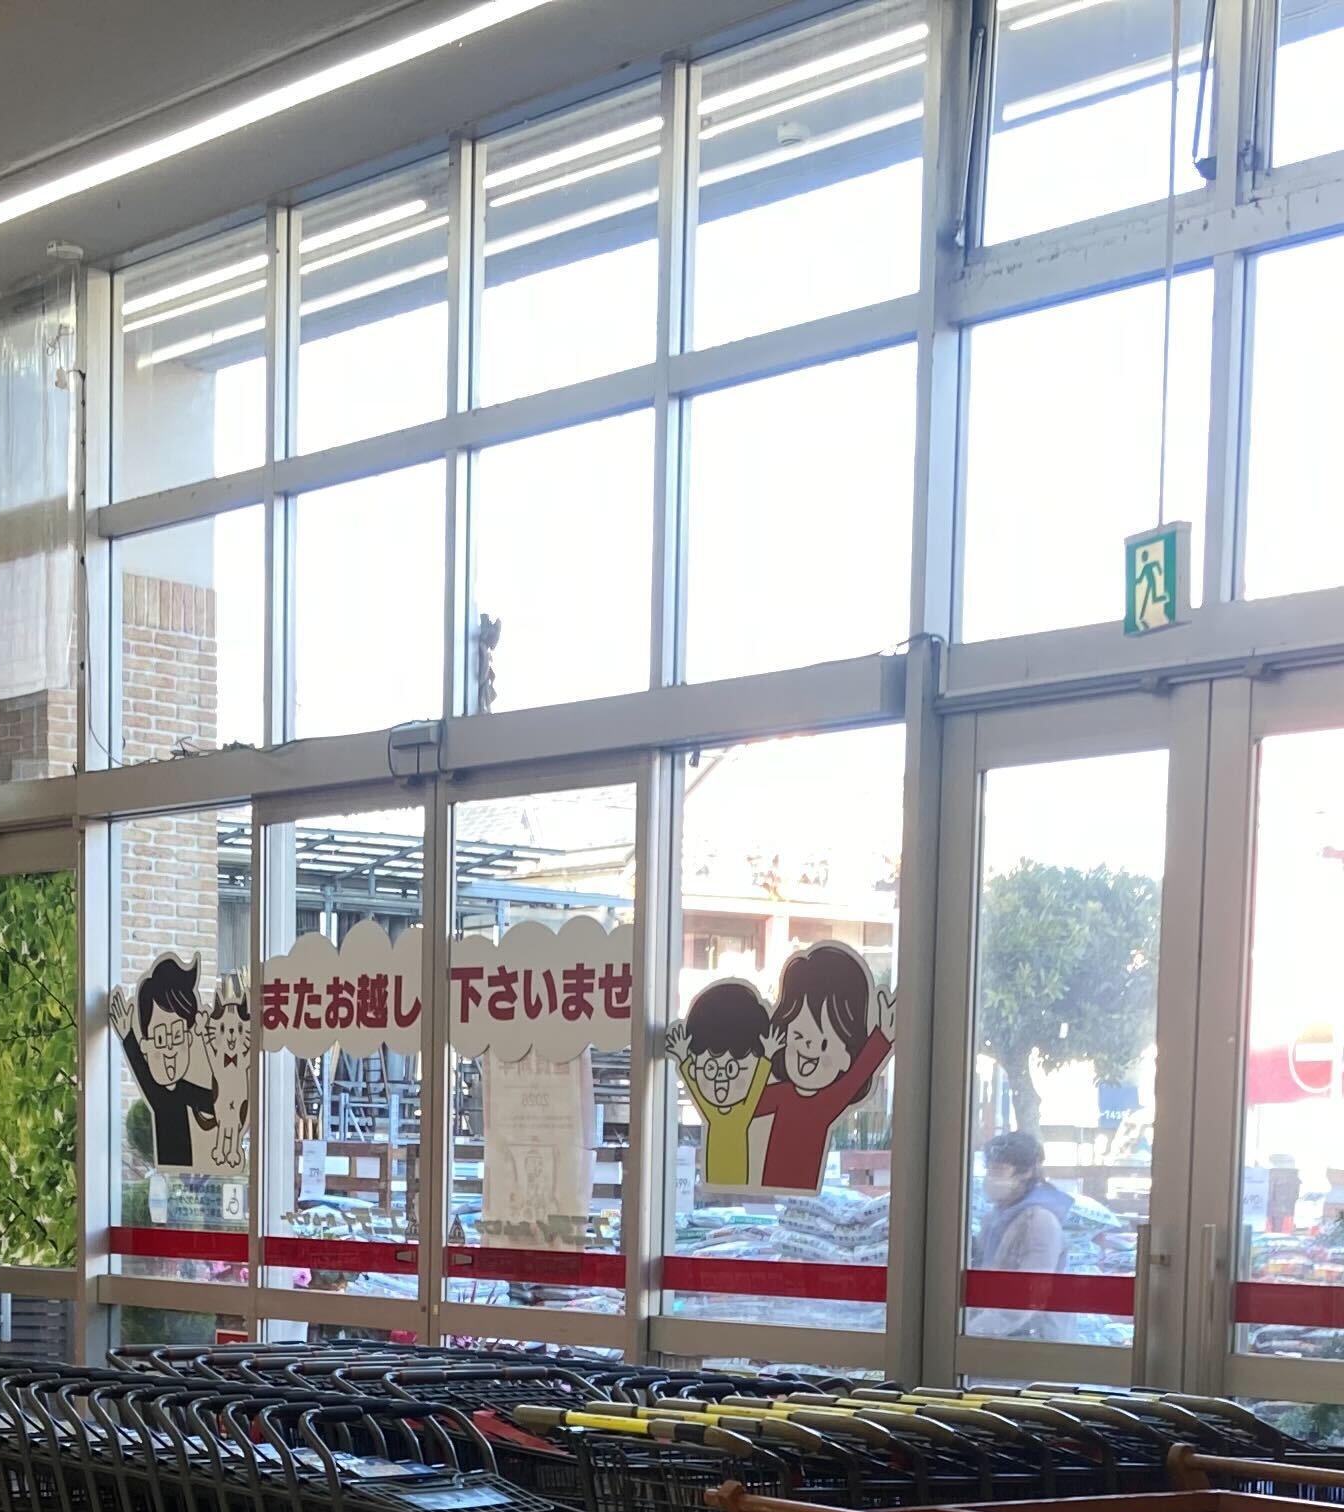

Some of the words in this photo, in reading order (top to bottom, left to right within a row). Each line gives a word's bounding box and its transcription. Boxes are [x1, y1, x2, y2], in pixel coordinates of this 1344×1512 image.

[259, 972, 423, 1031] またお越し
[447, 962, 634, 1025] 下さいませ
